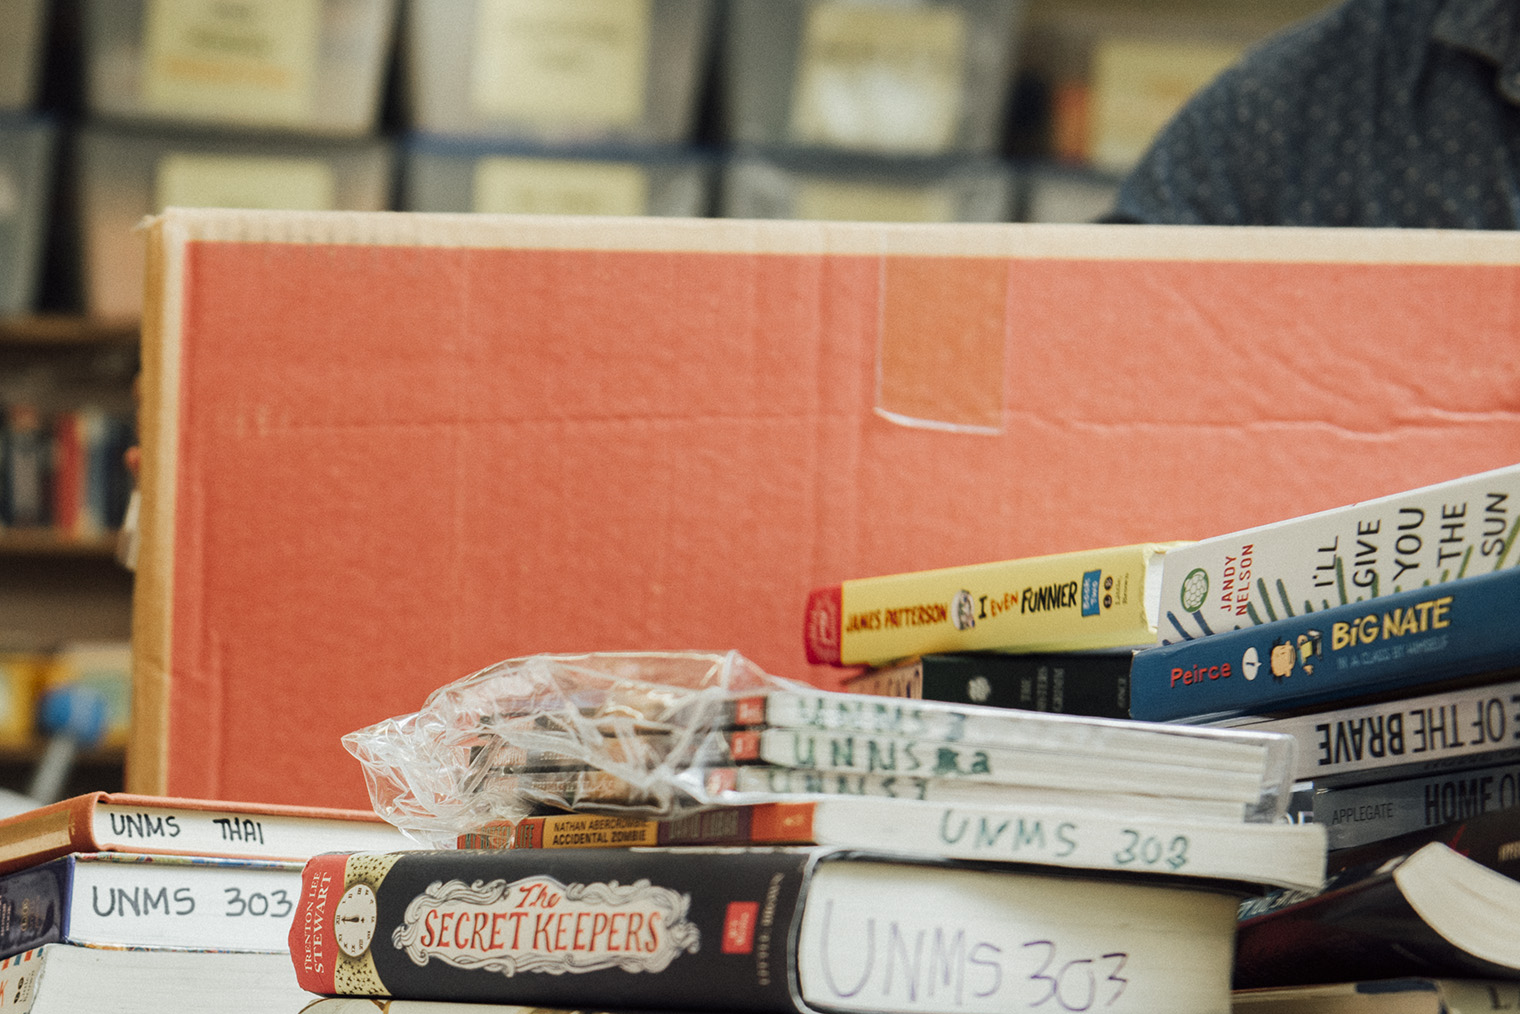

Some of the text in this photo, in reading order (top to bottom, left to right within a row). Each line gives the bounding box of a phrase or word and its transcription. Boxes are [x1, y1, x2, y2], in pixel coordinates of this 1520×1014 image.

[1392, 507, 1426, 583] YOU
[1438, 502, 1467, 568] THE
[1482, 492, 1509, 557] SUN
[1352, 519, 1381, 588] GIVE
[1021, 582, 1078, 614] FUNNIER
[1220, 555, 1238, 613] JANDY
[1236, 544, 1255, 617] NELSON
[846, 608, 881, 633] JAMES
[884, 603, 948, 630] PATTERSON
[1382, 596, 1455, 642] NATE
[1170, 662, 1232, 689] Peirce
[1316, 711, 1407, 767] BRAVE
[1408, 704, 1465, 761] THE
[1470, 697, 1508, 746] OF
[109, 813, 265, 845] UNMS THAI
[552, 830, 609, 846] ACCIDENTAL
[553, 820, 587, 832] NATHAN
[1332, 801, 1394, 825] APPLEGATE
[940, 808, 1190, 871] UNMS 303
[91, 884, 295, 919] UNMS 303
[312, 871, 333, 974] STEWART
[514, 883, 561, 911] The
[303, 900, 317, 974] TRENTON
[420, 909, 662, 955] SECRET KEEPERS
[821, 899, 1004, 1007] UNMS
[1022, 940, 1129, 1012] 303
